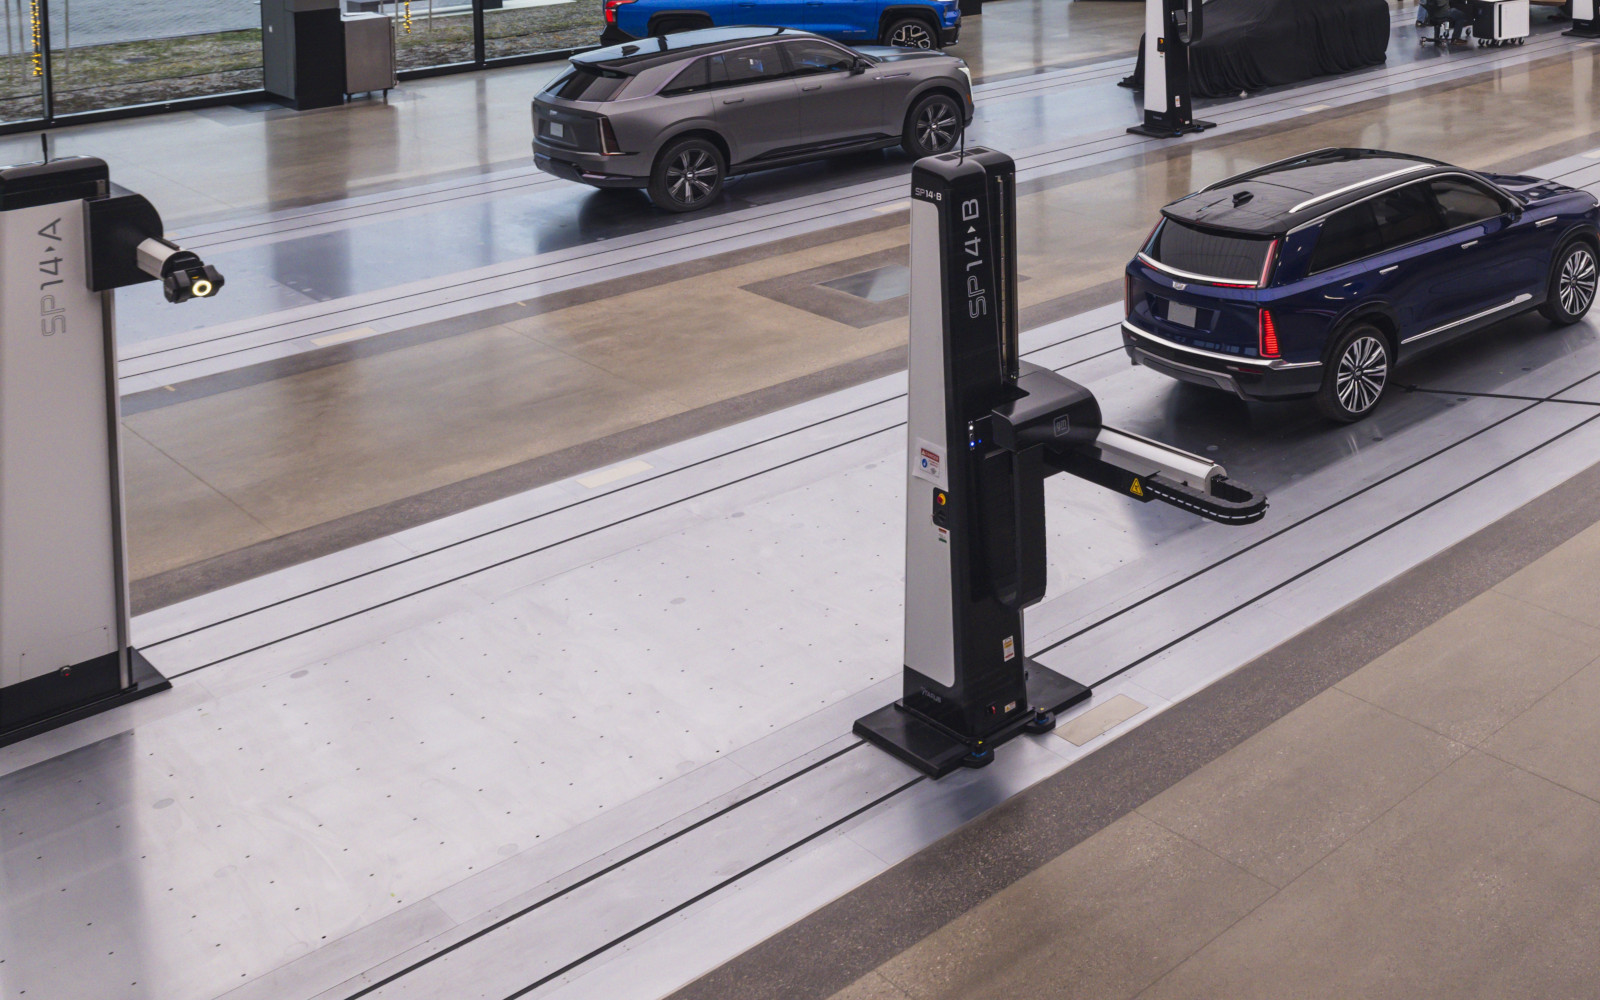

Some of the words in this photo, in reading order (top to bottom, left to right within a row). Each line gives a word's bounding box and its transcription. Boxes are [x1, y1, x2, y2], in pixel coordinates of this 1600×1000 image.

[915, 187, 934, 199] SP14
[961, 198, 980, 222] B
[37, 217, 63, 241] A
[964, 236, 987, 319] SP14
[39, 256, 66, 337] SP14
